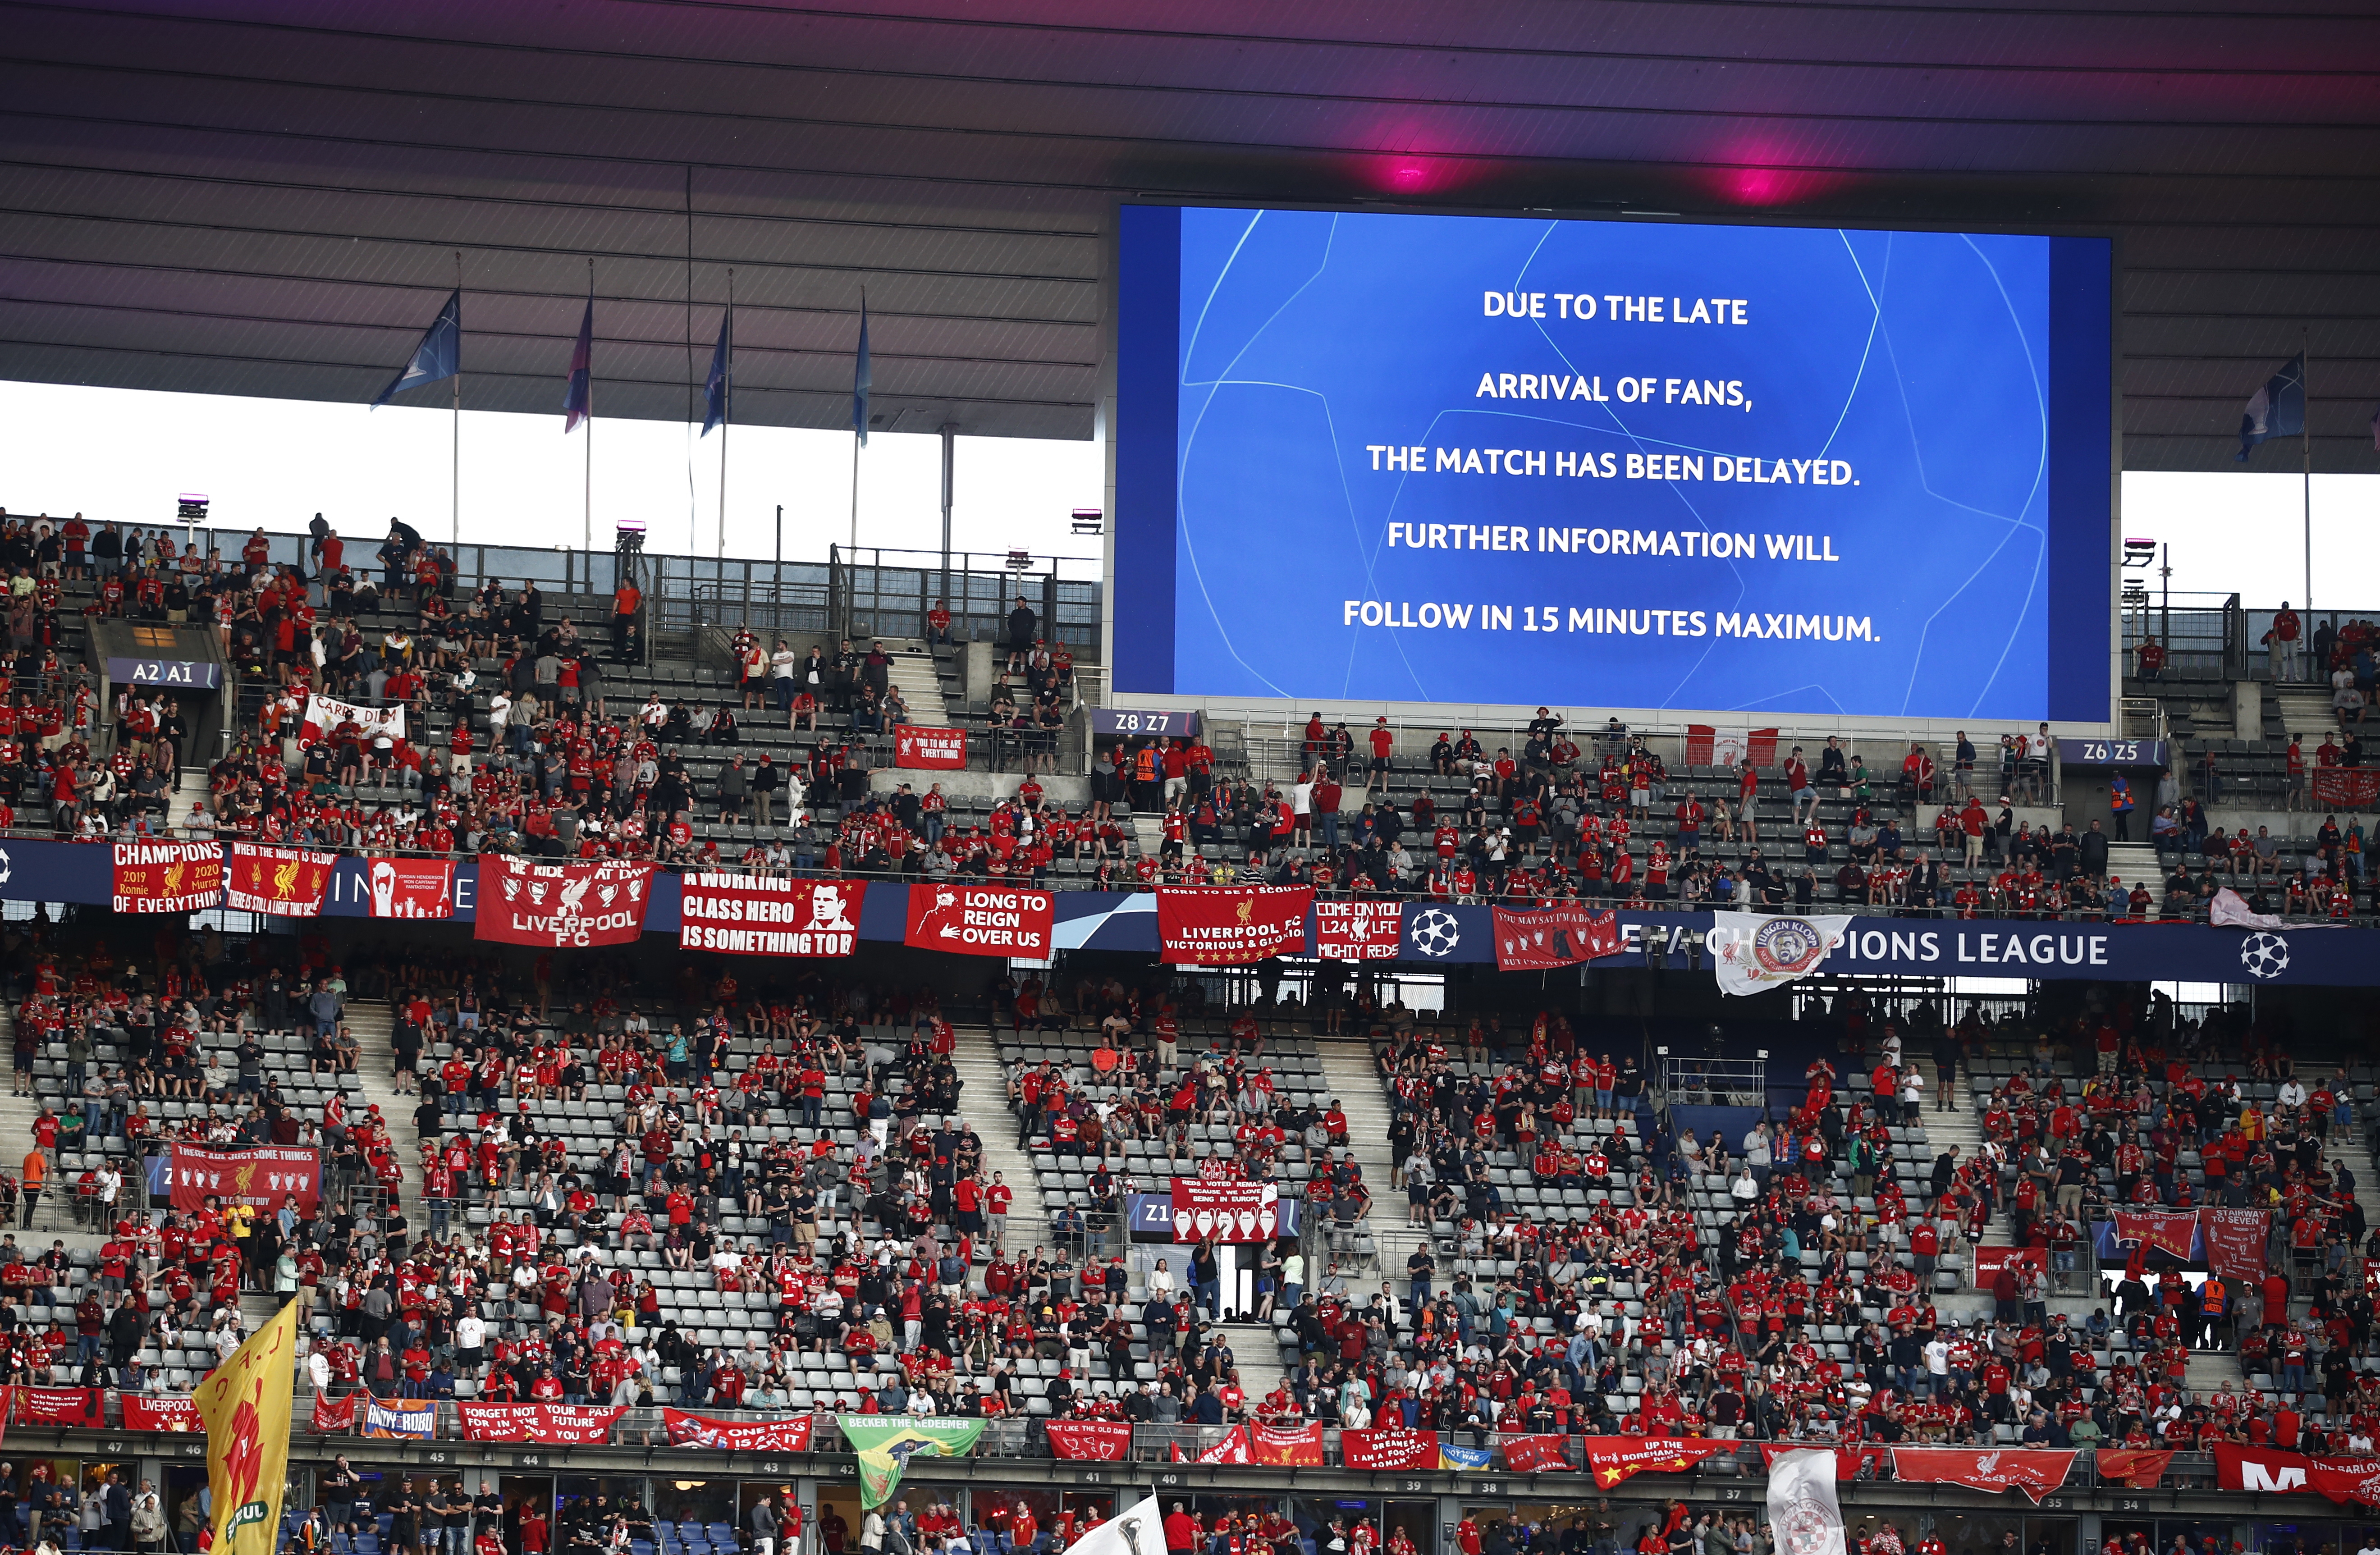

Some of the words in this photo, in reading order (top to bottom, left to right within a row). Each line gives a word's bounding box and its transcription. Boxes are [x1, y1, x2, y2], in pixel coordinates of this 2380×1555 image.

[1484, 292, 1546, 318] DUE
[1554, 294, 1596, 319] TO
[1604, 296, 1664, 322] THE
[1674, 298, 1748, 325] LATE
[1476, 373, 1609, 401] ARRIVAL
[1617, 377, 1657, 402] OF
[1666, 379, 1752, 412] FANS,
[1366, 445, 1426, 471] THE
[1436, 448, 1545, 475] MATCH
[1556, 452, 1616, 478] HAS
[1627, 454, 1703, 480] BEEN
[1714, 456, 1859, 485] DELAYED.
[1389, 522, 1529, 551] FURTHER
[1539, 527, 1755, 558] INFORMATION
[1764, 535, 1839, 561] WILL
[1345, 601, 1473, 628] FOLLOW
[1482, 605, 1512, 630] IN
[1524, 606, 1558, 631] 15
[1569, 608, 1706, 636] MINUTES
[1716, 613, 1880, 641] MAXIMUM.
[133, 664, 158, 680] A2
[167, 666, 192, 682] A1
[1116, 714, 1138, 730] Z8
[1146, 716, 1168, 731] Z7
[916, 738, 928, 747] YOU
[929, 739, 937, 748] TO
[939, 740, 948, 748] ME
[950, 740, 961, 749] ARE
[922, 748, 958, 759] EVERYTHING
[2084, 744, 2106, 759] Z6
[2115, 745, 2137, 760] Z5
[115, 842, 223, 865] CHAMPIONS
[234, 842, 256, 856] WHEN
[259, 846, 273, 858] THE
[276, 849, 298, 860] NIGHT
[302, 851, 309, 862] IS
[124, 871, 146, 882] 2019
[195, 864, 219, 878] 2020
[534, 866, 564, 878] RIDE
[595, 868, 613, 879] AT
[120, 884, 148, 894] Ronnie
[192, 879, 219, 890] Murray
[700, 873, 791, 892] WORKING
[114, 896, 130, 912] OF
[137, 887, 221, 912] EVERYTHIN
[229, 889, 246, 908] THERE
[252, 896, 266, 912] STILL
[273, 901, 289, 915] LIGHT
[290, 902, 303, 915] THAT
[966, 892, 1016, 909] LONG
[1021, 896, 1046, 911] TO
[684, 896, 742, 920] CLASS
[746, 901, 794, 923] HERO
[1316, 903, 1352, 916] COME
[1355, 903, 1374, 916] ON
[1376, 903, 1402, 916] YOU
[513, 910, 636, 933] LIVERPOOL
[964, 910, 1019, 927] REIGN
[1498, 913, 1515, 923] YOU
[1539, 915, 1554, 924] SAY
[1183, 924, 1279, 938] LIVERPOOL
[1285, 916, 1300, 930] FC
[1322, 920, 1348, 933] L24
[1373, 921, 1396, 933] LFC
[683, 926, 701, 946] IS
[704, 928, 811, 953] SOMETHING
[815, 934, 838, 954] TO
[963, 928, 1012, 945] OVER
[1018, 932, 1040, 947] US
[1757, 921, 1789, 946] JÜRGEN
[1792, 922, 1817, 946] KLOPP
[1166, 940, 1243, 950] VICTORIOUS
[1318, 944, 1363, 957] MIGHTY
[1367, 944, 1398, 958] REDS
[1959, 933, 2108, 964] LEAGUE
[253, 1150, 278, 1159] SOME
[279, 1151, 312, 1161] THINGS
[2228, 1216, 2258, 1225] SEVEN
[140, 1399, 194, 1411] LIVERPOOL
[465, 1408, 508, 1418] FORGET
[513, 1407, 536, 1417] NOT
[545, 1405, 576, 1415] YOUR
[589, 1407, 616, 1417] PAST
[367, 1404, 397, 1429] ANDY
[403, 1413, 433, 1431] ROBO
[468, 1418, 489, 1427] FOR
[553, 1416, 595, 1427] FUTURE
[849, 1418, 888, 1427] BECKER
[891, 1419, 911, 1427] THE
[915, 1419, 969, 1429] REDEEMER
[471, 1429, 481, 1440] IT
[490, 1427, 516, 1436] MAY
[556, 1430, 579, 1440] YOU
[728, 1427, 765, 1436] ONE
[108, 1443, 122, 1451] 47
[186, 1445, 201, 1454] 46
[1373, 1439, 1415, 1450] DREAMER
[430, 1453, 444, 1462] 45
[523, 1456, 538, 1464] 44
[1622, 1450, 1673, 1462] BOREHAM
[764, 1463, 778, 1472] 43
[840, 1465, 854, 1474] 42
[1086, 1473, 1099, 1482] 41
[1163, 1475, 1176, 1484] 40
[1407, 1482, 1421, 1490] 39
[1483, 1484, 1497, 1492] 38
[1727, 1490, 1740, 1499] 37
[2048, 1499, 2061, 1507] 35
[2124, 1501, 2138, 1509] 34
